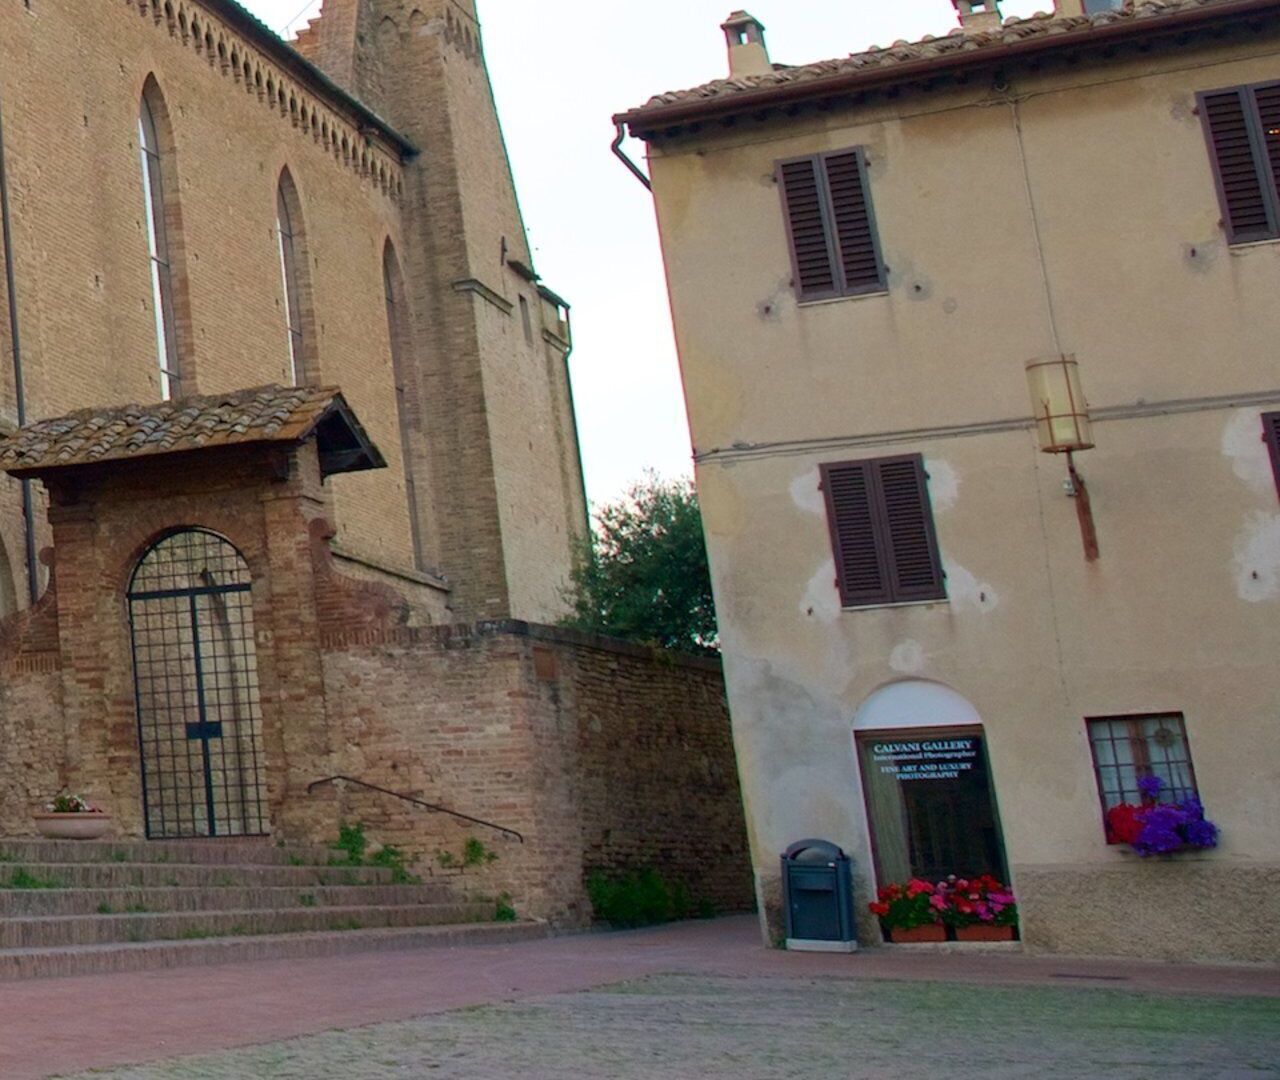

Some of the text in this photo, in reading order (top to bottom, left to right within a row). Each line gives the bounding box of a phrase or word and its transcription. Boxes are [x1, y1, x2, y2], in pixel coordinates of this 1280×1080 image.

[874, 740, 972, 753] CALVANI GALLERY
[874, 751, 976, 761] International Photographer
[881, 765, 899, 773] FINE
[902, 764, 917, 772] ART
[896, 771, 959, 780] PHOTOGRAPHY
